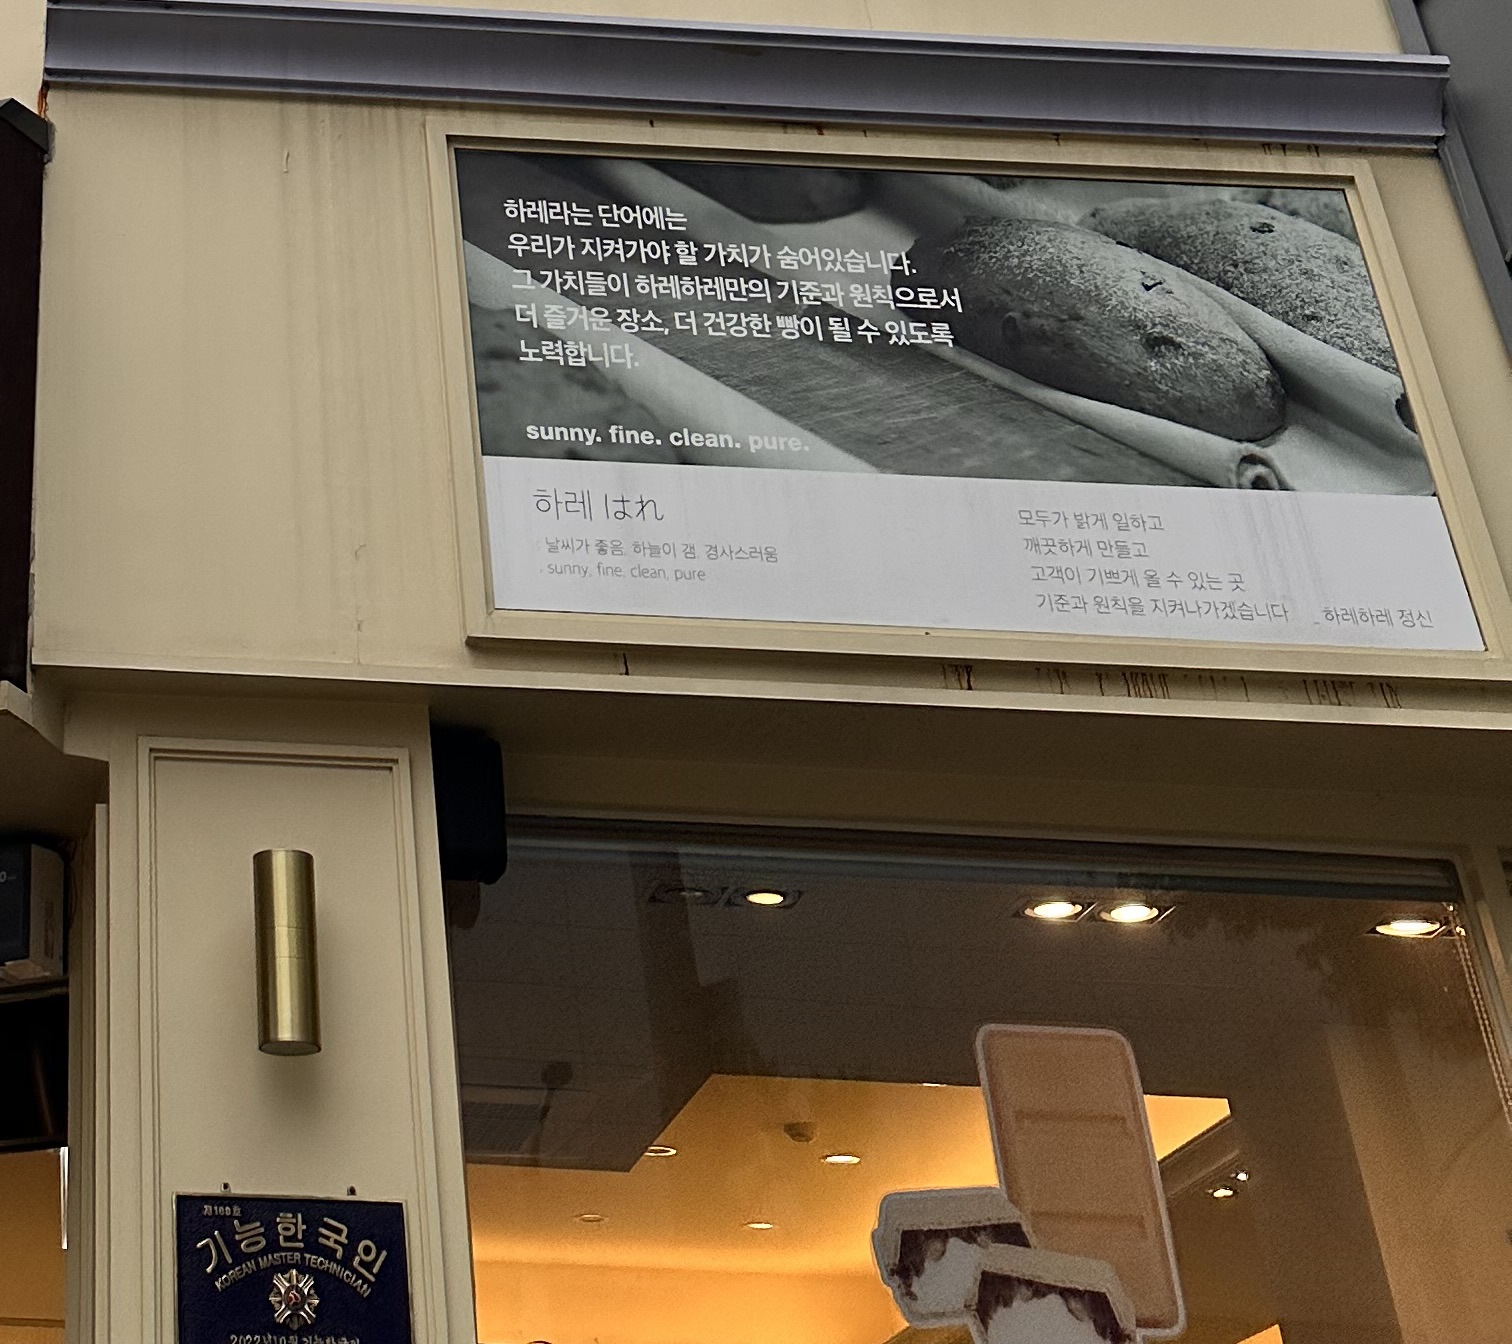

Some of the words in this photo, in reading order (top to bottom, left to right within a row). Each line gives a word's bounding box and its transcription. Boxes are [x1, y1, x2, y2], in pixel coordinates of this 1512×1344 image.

[504, 198, 593, 226] 하레라는
[598, 203, 687, 230] 단어에는
[508, 233, 575, 260] 우리가
[580, 236, 670, 264] 지켜가야
[674, 241, 698, 266] 할
[703, 242, 772, 269] 가치가
[776, 246, 917, 276] 숨어있습니다.
[512, 269, 535, 289] 그
[539, 269, 630, 297] 가치들이
[635, 273, 772, 303] 하레하레만의
[776, 280, 844, 307] 기준과
[849, 283, 963, 313] 원칙으로서
[515, 303, 538, 328] 더
[543, 304, 612, 331] 즐거운
[616, 308, 669, 335] 장소,
[674, 310, 697, 336] 더
[703, 312, 772, 338] 건강한
[776, 314, 823, 341] 빵이
[828, 316, 853, 343] 될
[857, 318, 881, 343] 수
[884, 320, 955, 347] 있도록
[518, 339, 639, 369] 노력합니다.
[526, 424, 602, 446] sunny.
[609, 425, 662, 445] fine.
[669, 428, 741, 448] clean.
[748, 432, 810, 452] pure.
[533, 488, 592, 522] 하레
[605, 493, 664, 521] はれ
[1018, 509, 1069, 529] 모두가
[1073, 512, 1108, 530] 밝게
[1112, 512, 1165, 532] 일하고
[545, 536, 590, 555] 날씨가
[631, 540, 677, 558] 하늘이
[705, 543, 779, 562] 경사스러움
[1023, 537, 1093, 557] 깨끗하게
[1096, 539, 1150, 559] 만들고
[674, 568, 707, 581] pure
[1031, 565, 1081, 585] 고객이
[1086, 567, 1140, 588] 기쁘게
[1166, 570, 1184, 589] 수
[1188, 571, 1223, 591] 있는
[1228, 572, 1245, 592] 곳
[1035, 592, 1088, 613] 기준과
[1093, 595, 1146, 617] 원칙을
[1149, 597, 1289, 623] 지켜나가겠습니다
[1398, 609, 1434, 629] 정신
[196, 1212, 387, 1283] 기능한국인
[214, 1260, 257, 1292] KOREAN
[259, 1252, 301, 1270] MASTER
[304, 1252, 372, 1299] TECHNICIAN
